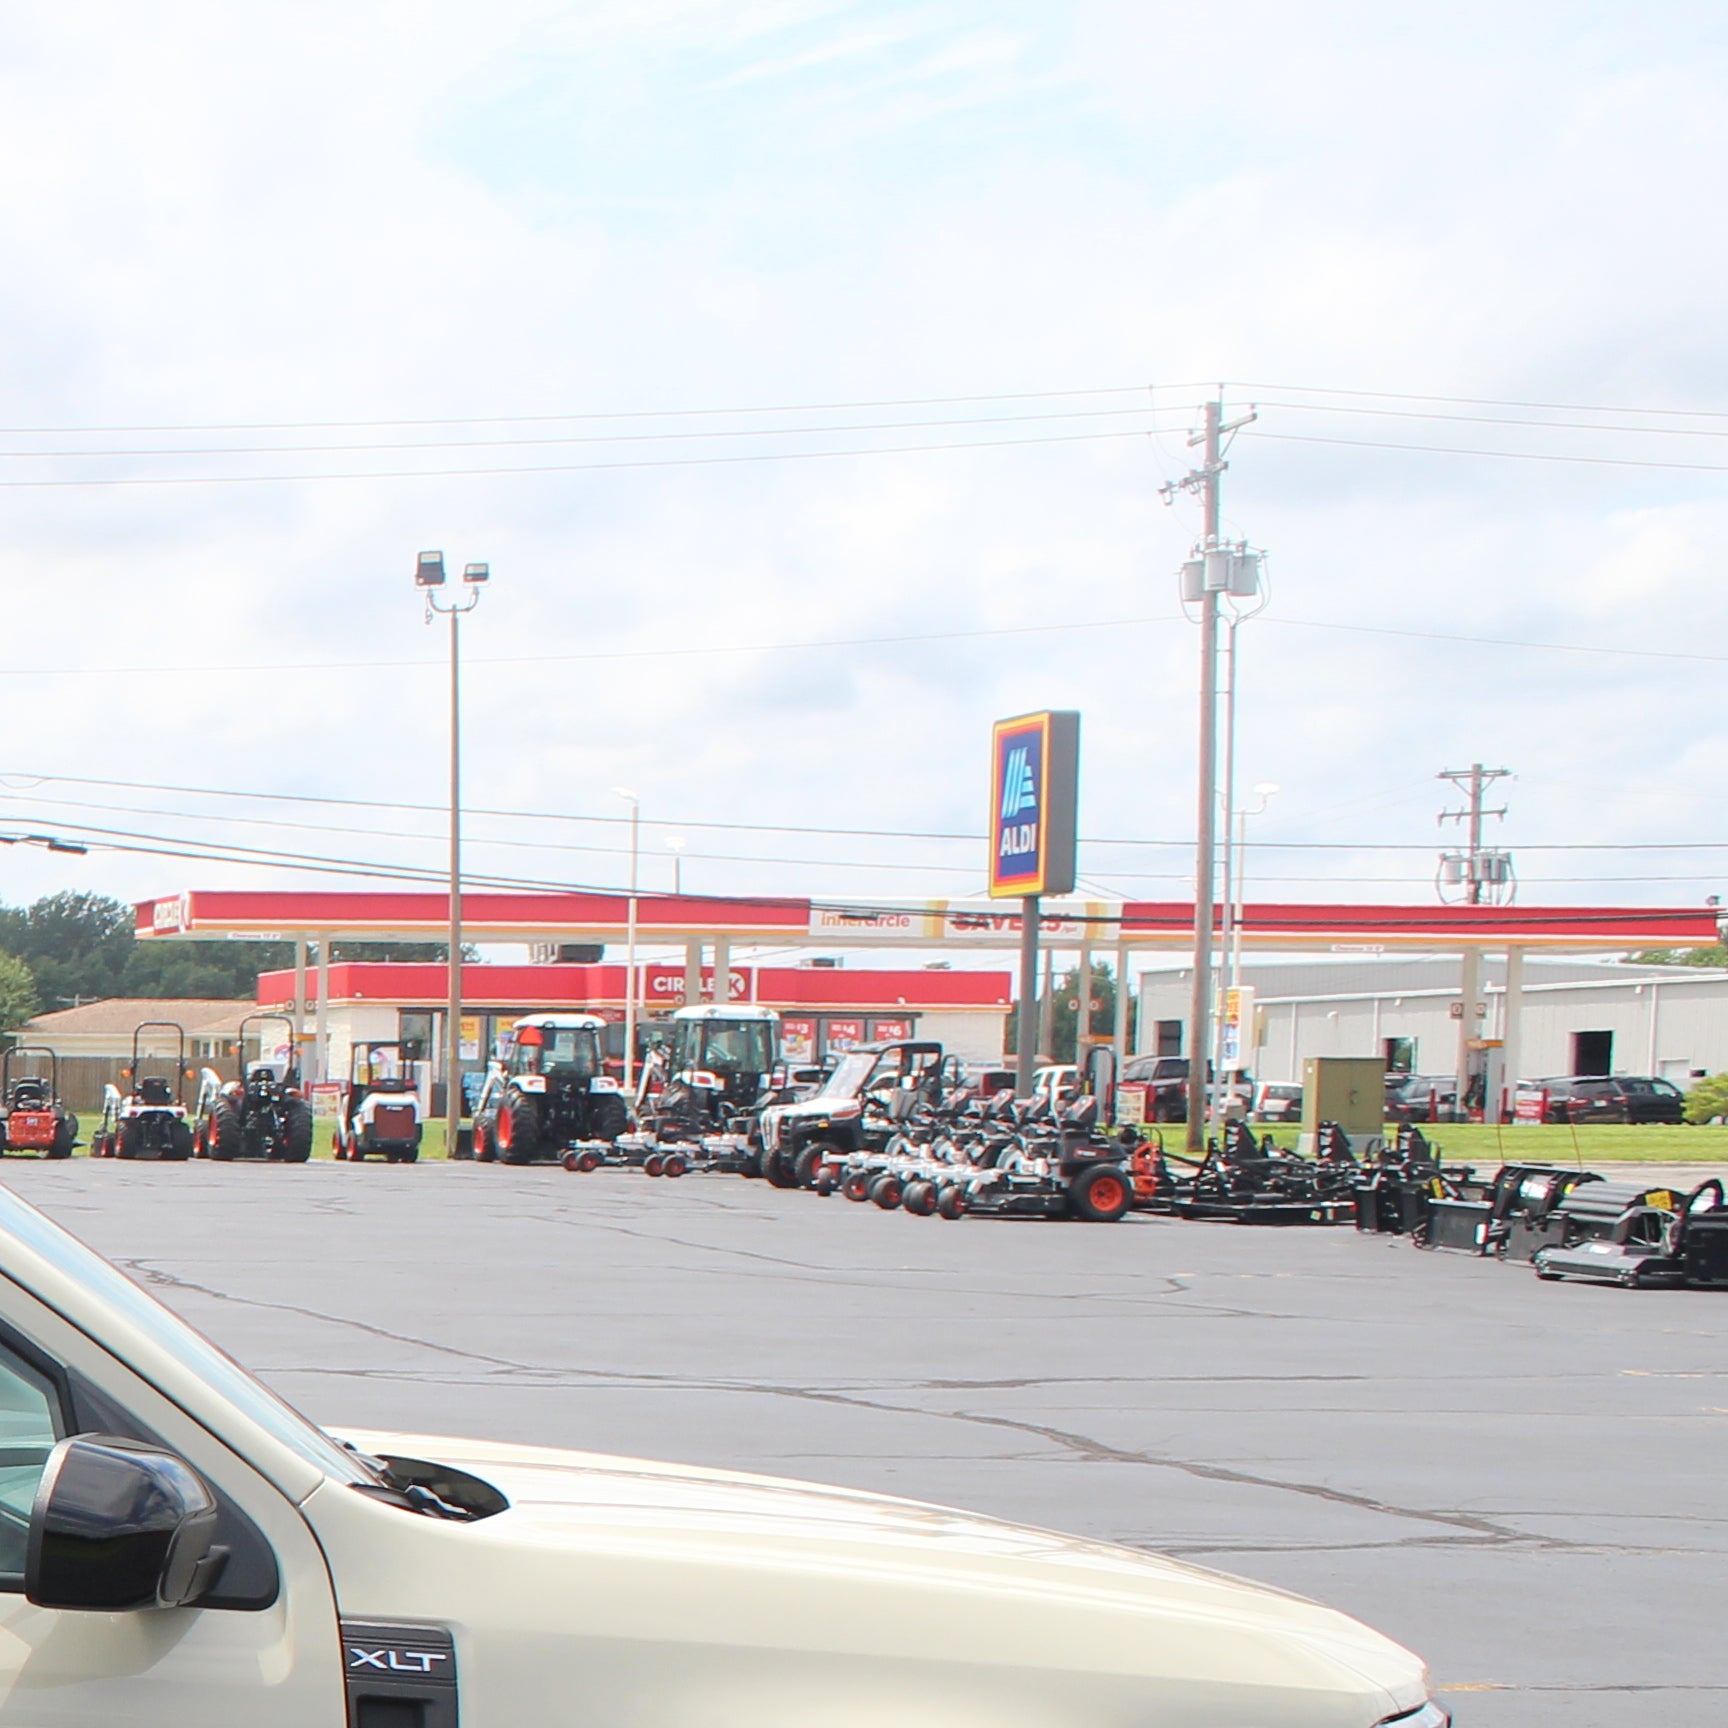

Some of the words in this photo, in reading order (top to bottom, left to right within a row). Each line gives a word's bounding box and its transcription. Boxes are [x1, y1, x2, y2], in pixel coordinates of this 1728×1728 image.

[1000, 822, 1037, 857] ALDI
[652, 976, 715, 993] CIRLE
[350, 1648, 446, 1672] XLT
